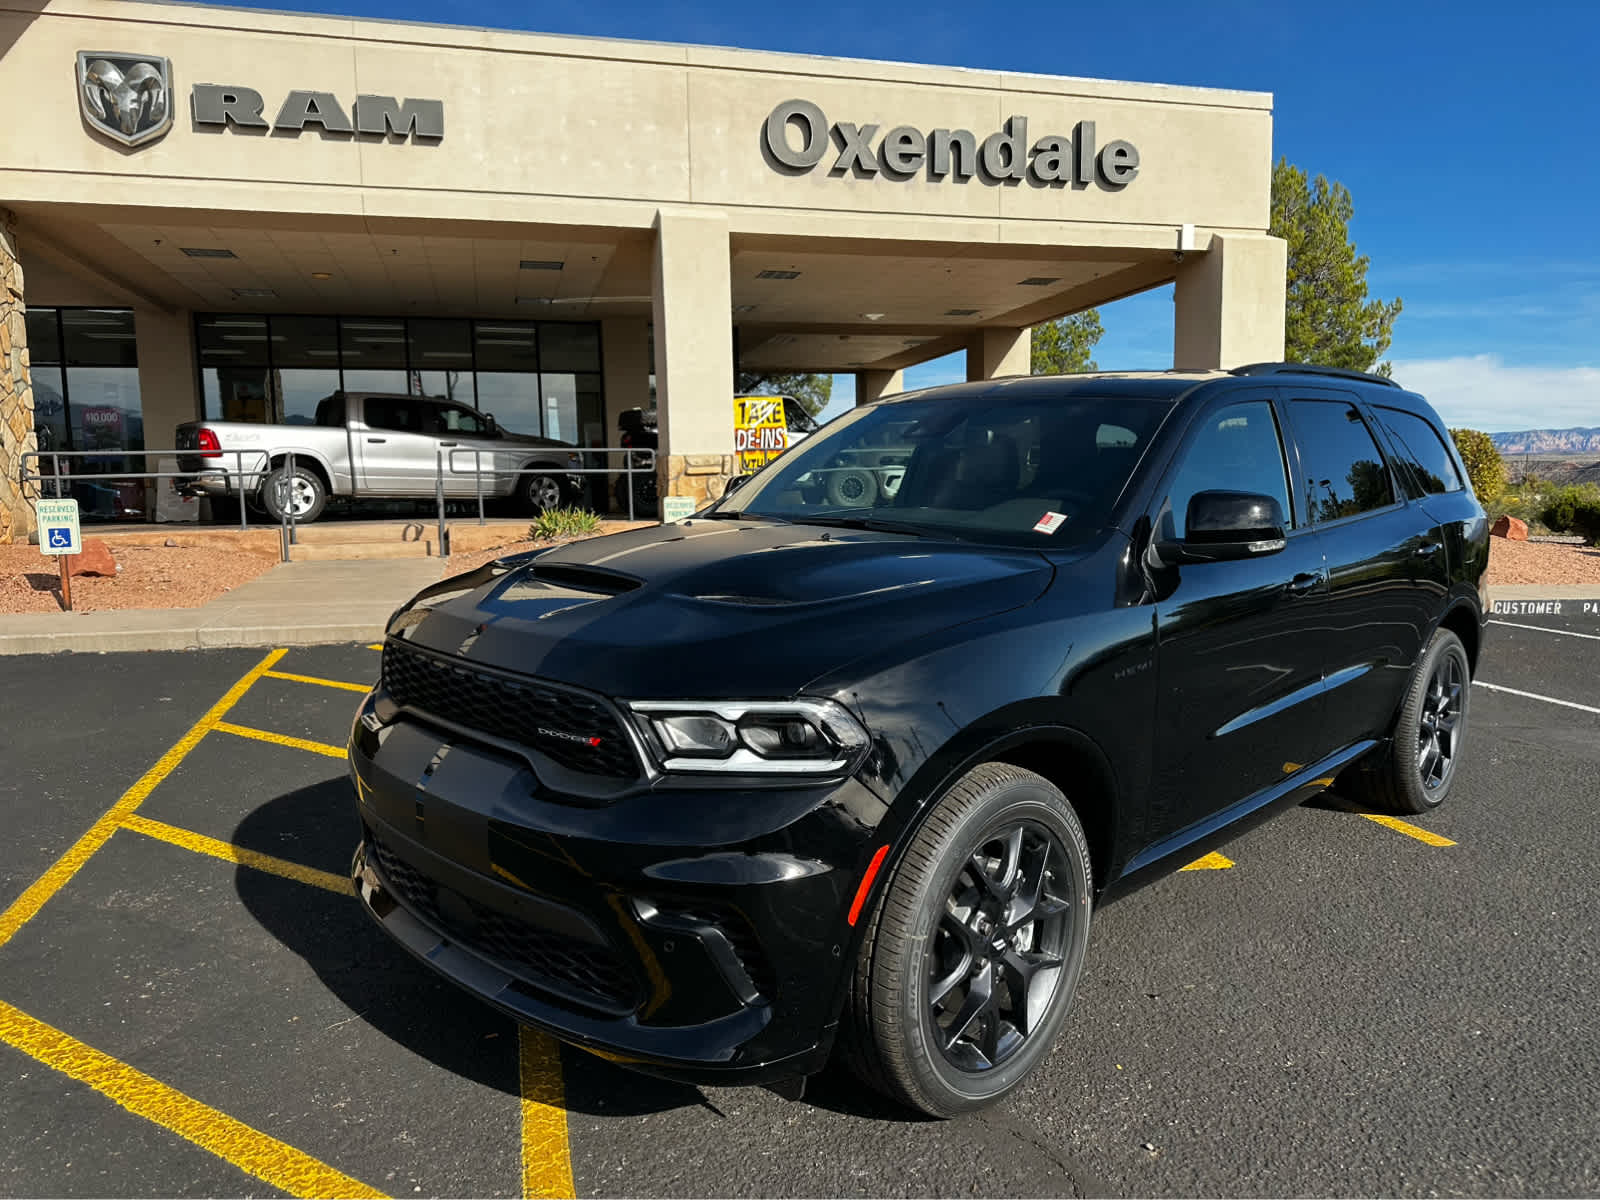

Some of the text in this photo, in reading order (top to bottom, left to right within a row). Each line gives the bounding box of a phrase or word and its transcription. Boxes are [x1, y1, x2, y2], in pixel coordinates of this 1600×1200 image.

[191, 83, 444, 142] RAM
[763, 98, 1140, 188] Oxendale
[736, 428, 784, 451] DE-INS
[39, 505, 75, 513] RESERVED
[42, 515, 74, 523] PARKING
[1494, 601, 1600, 615] CUSTOMER PA
